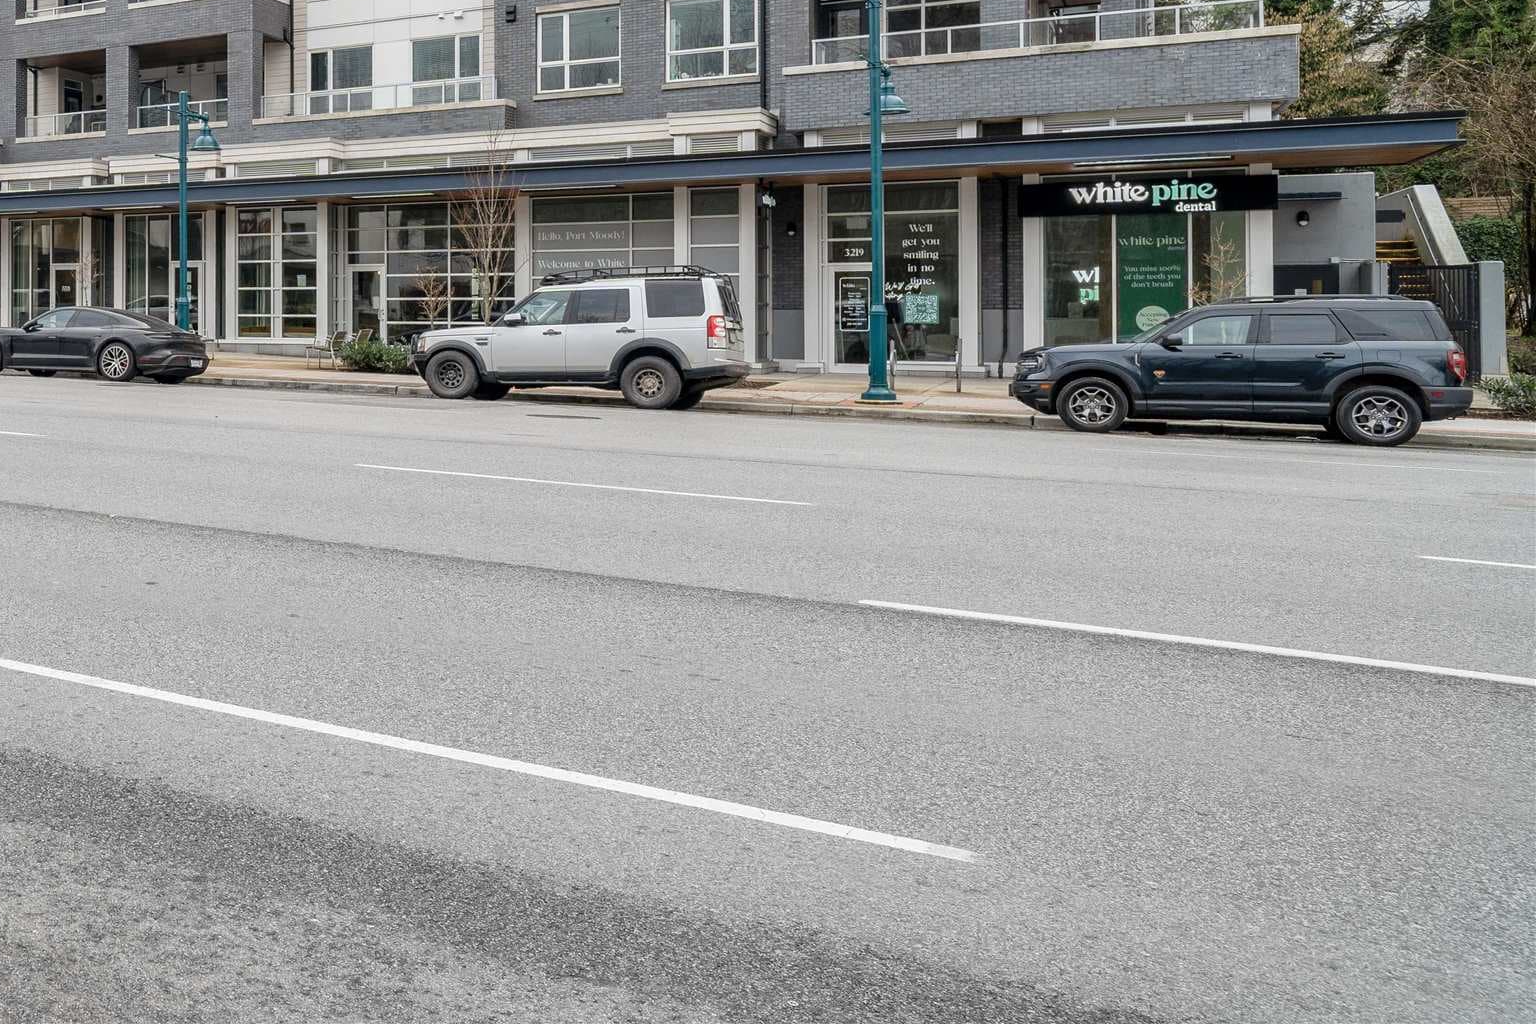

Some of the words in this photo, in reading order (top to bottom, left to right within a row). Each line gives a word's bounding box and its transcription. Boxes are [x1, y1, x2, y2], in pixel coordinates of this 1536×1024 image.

[1069, 182, 1149, 205] white
[1151, 179, 1217, 207] pine
[1175, 201, 1217, 212] dental
[908, 224, 933, 233] We'll
[537, 231, 563, 241] Hello,
[566, 231, 586, 241] Port
[590, 230, 625, 241] Moody!
[902, 238, 917, 248] get
[921, 239, 940, 248] you
[1118, 236, 1154, 247] white
[1157, 234, 1185, 248] pine
[844, 248, 865, 257] 3219
[903, 250, 939, 260] smiling
[537, 258, 583, 269] Welcome
[584, 259, 594, 268] to
[907, 263, 917, 272] in
[921, 264, 935, 272] no
[1124, 265, 1138, 273] You
[1139, 264, 1158, 273] miss
[1159, 264, 1181, 272] 100%
[909, 276, 935, 286] time.
[1167, 273, 1181, 281] you
